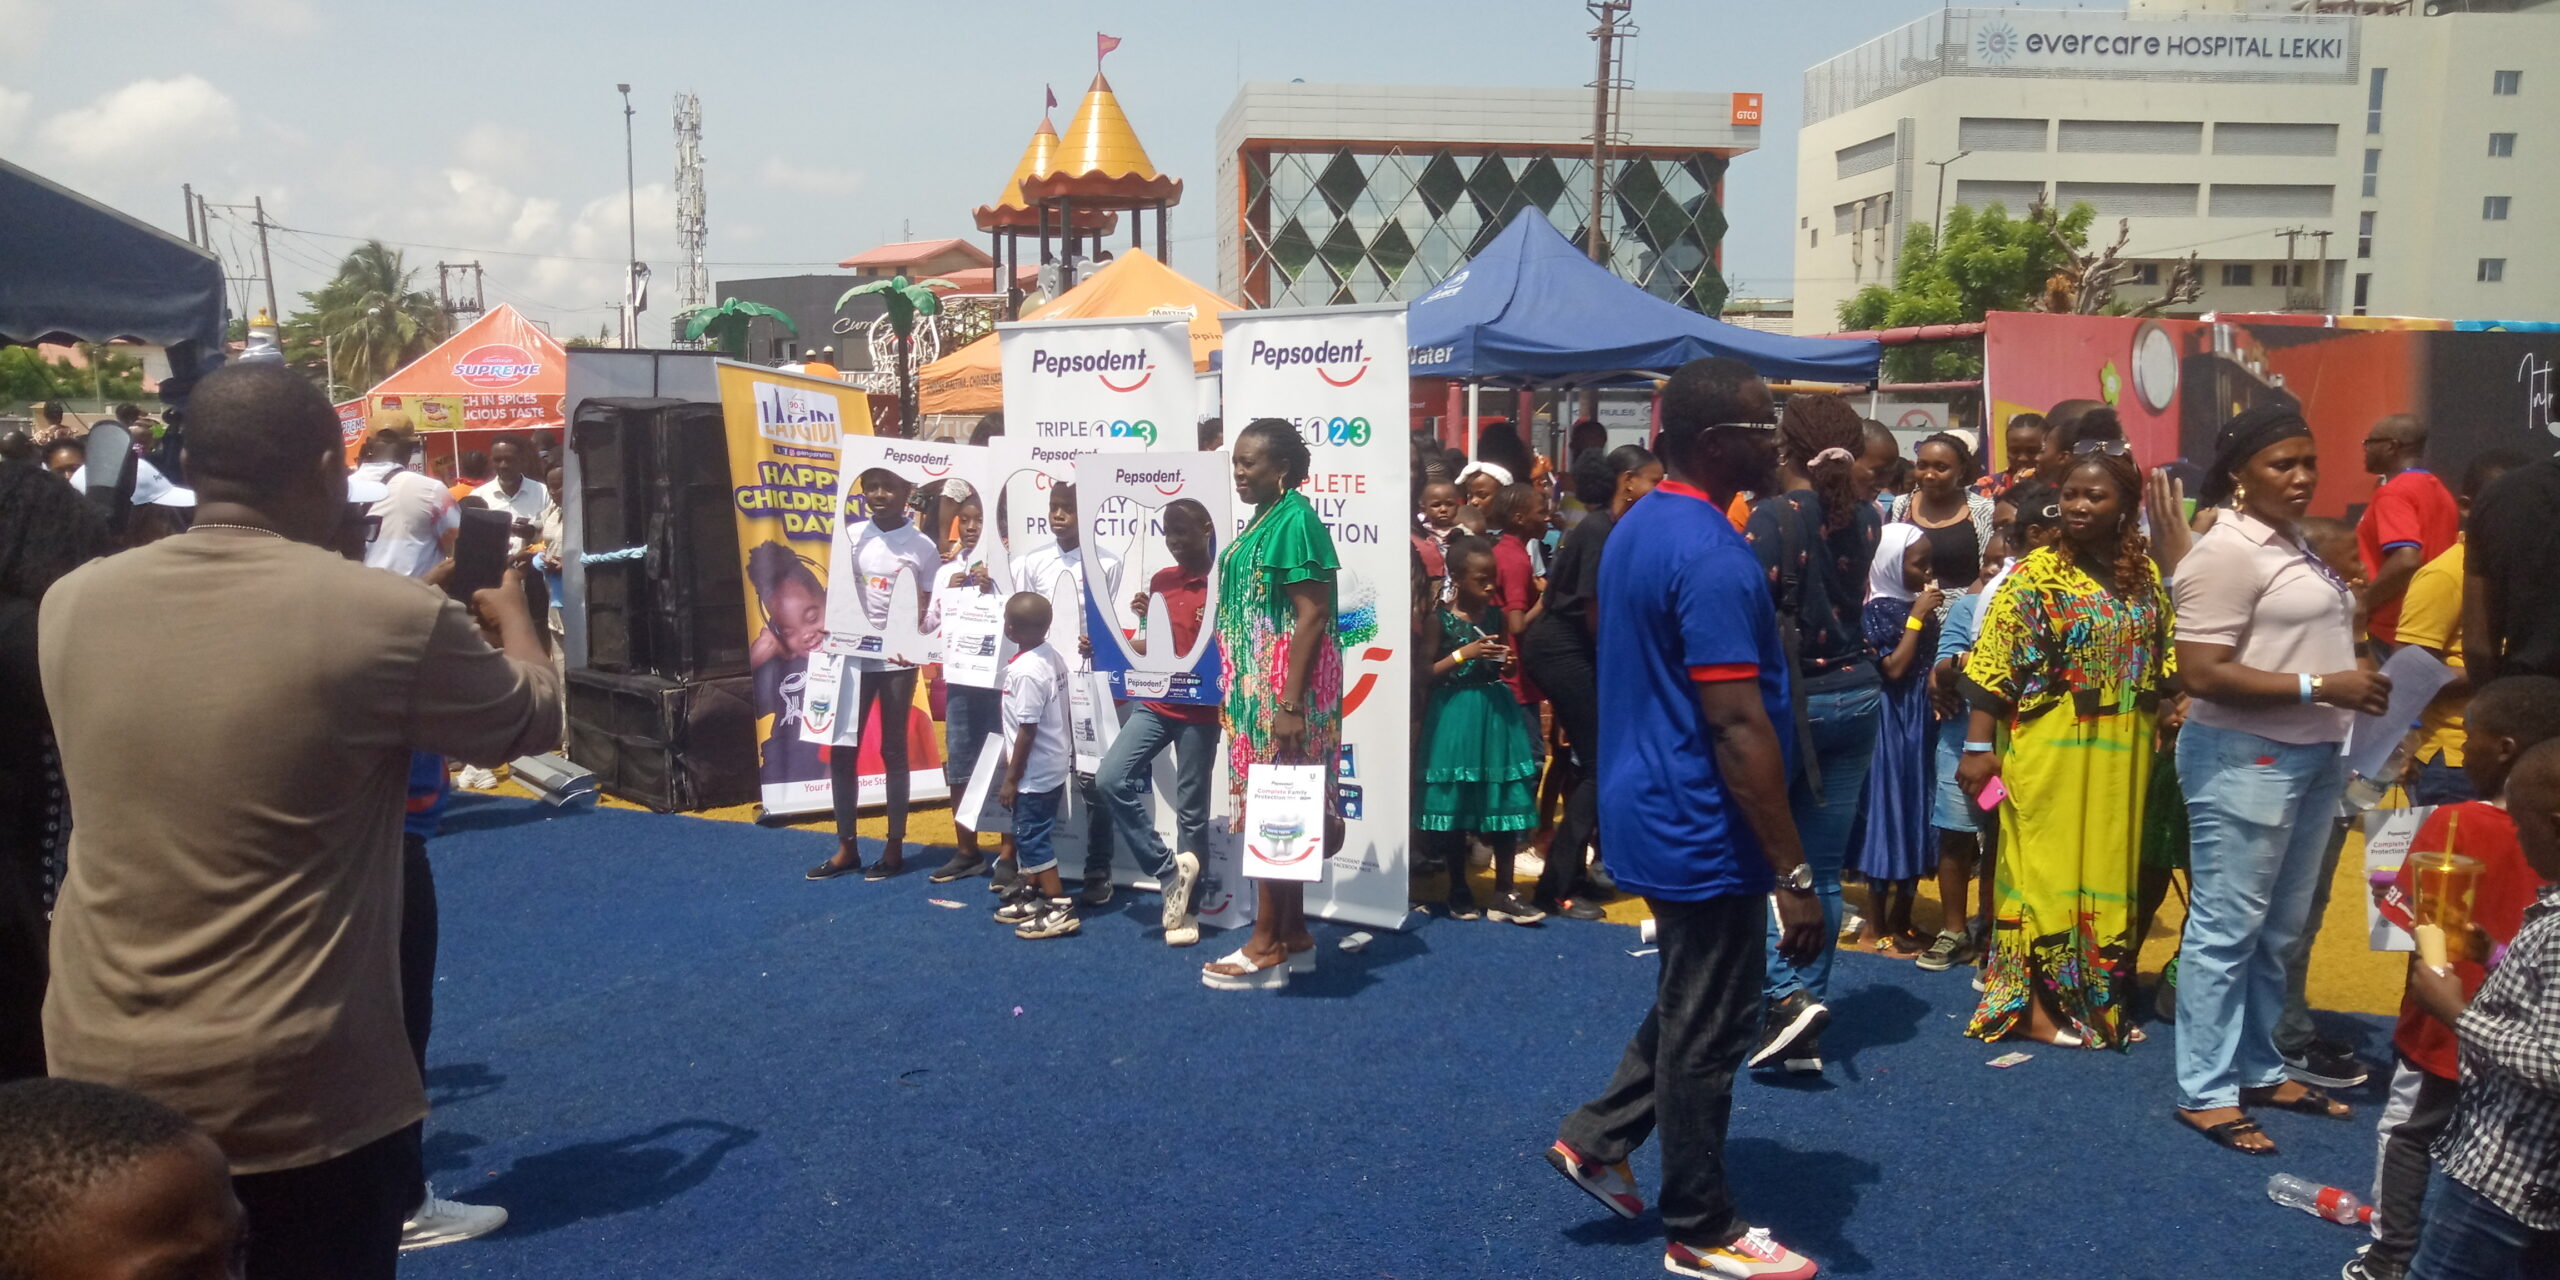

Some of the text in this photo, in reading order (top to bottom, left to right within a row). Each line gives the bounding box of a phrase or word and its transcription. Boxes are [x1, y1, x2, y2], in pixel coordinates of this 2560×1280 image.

[2026, 33, 2342, 60] evercare HOSPITAL LEKKI
[1737, 111, 1757, 119] GTCO
[1251, 339, 1364, 370] Pepsodent
[452, 364, 541, 378] SUPREME
[1032, 349, 1147, 378] Pepsodent
[482, 396, 494, 405] IN
[498, 393, 538, 405] SPICES
[510, 407, 545, 418] TASTE
[1036, 422, 1088, 437] TRIPLE
[884, 448, 949, 467] Pepsodent
[1116, 469, 1182, 485] Pepsodent
[784, 514, 835, 535] DAY
[1127, 678, 1162, 688] Pepsodent
[804, 783, 824, 792] Your
